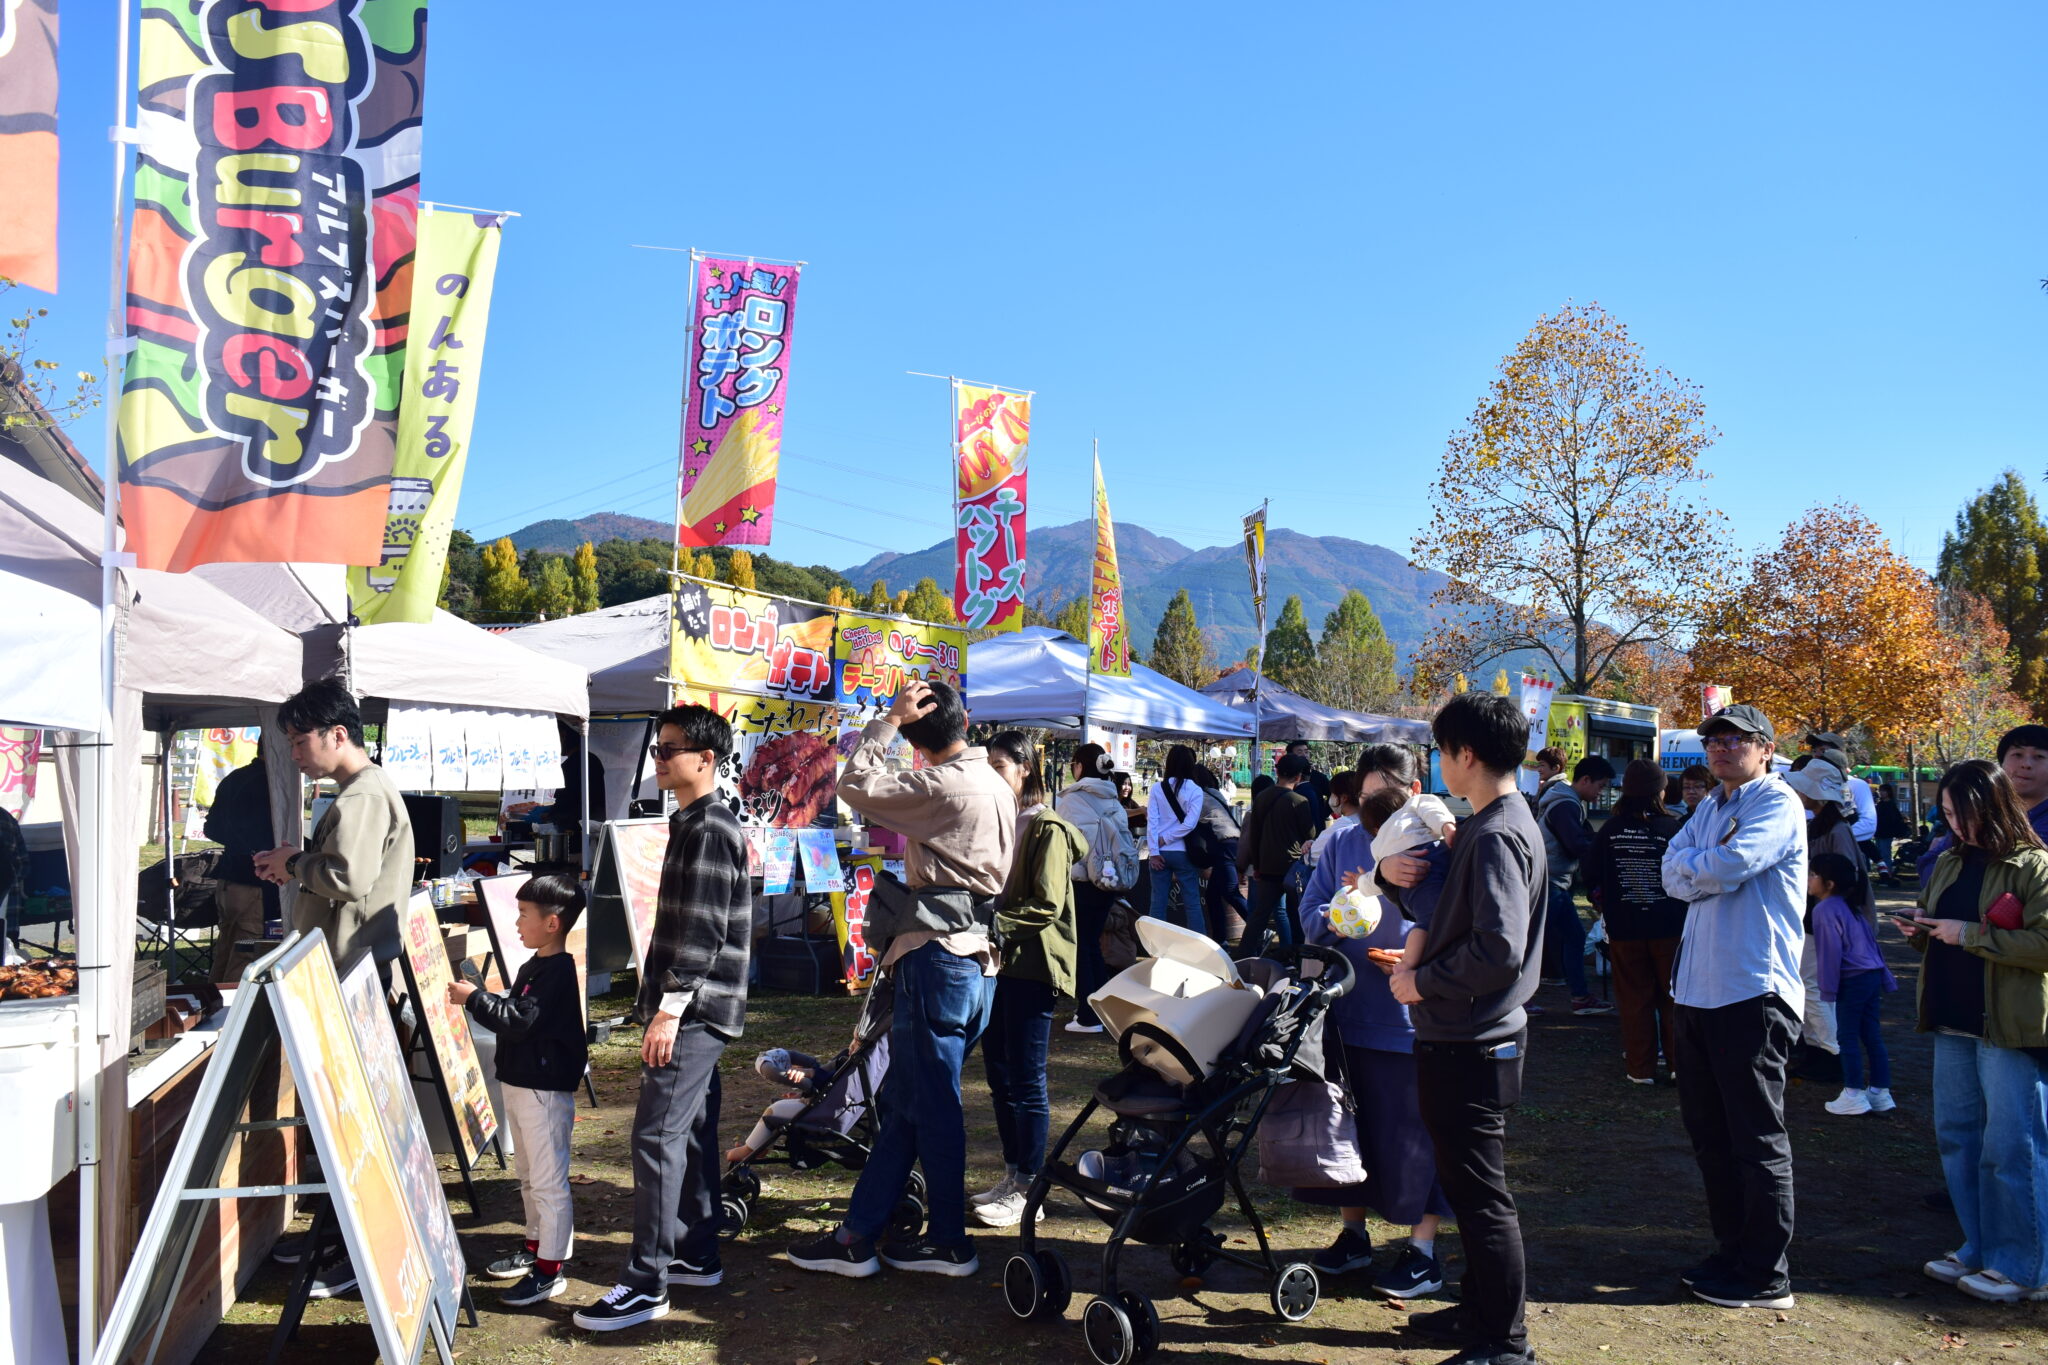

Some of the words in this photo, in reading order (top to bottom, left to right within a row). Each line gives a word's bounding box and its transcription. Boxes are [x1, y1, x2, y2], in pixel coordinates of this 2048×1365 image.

[203, 86, 333, 463] Burger
[311, 170, 353, 437] アルプスバーガー
[421, 272, 470, 458] のんある
[698, 310, 745, 429] ポテト
[735, 295, 787, 408] ロング
[958, 504, 1000, 629] ハットグ
[989, 487, 1026, 603] チーズ
[680, 590, 702, 612] 揚げ
[688, 611, 707, 630] たて
[709, 604, 779, 662] ロング
[842, 625, 870, 641] Cheese
[852, 635, 868, 650] Hot
[866, 630, 883, 645] Dog
[1100, 587, 1122, 672] ポテト
[766, 635, 831, 694] ポテト
[1186, 1175, 1207, 1191] Combi
